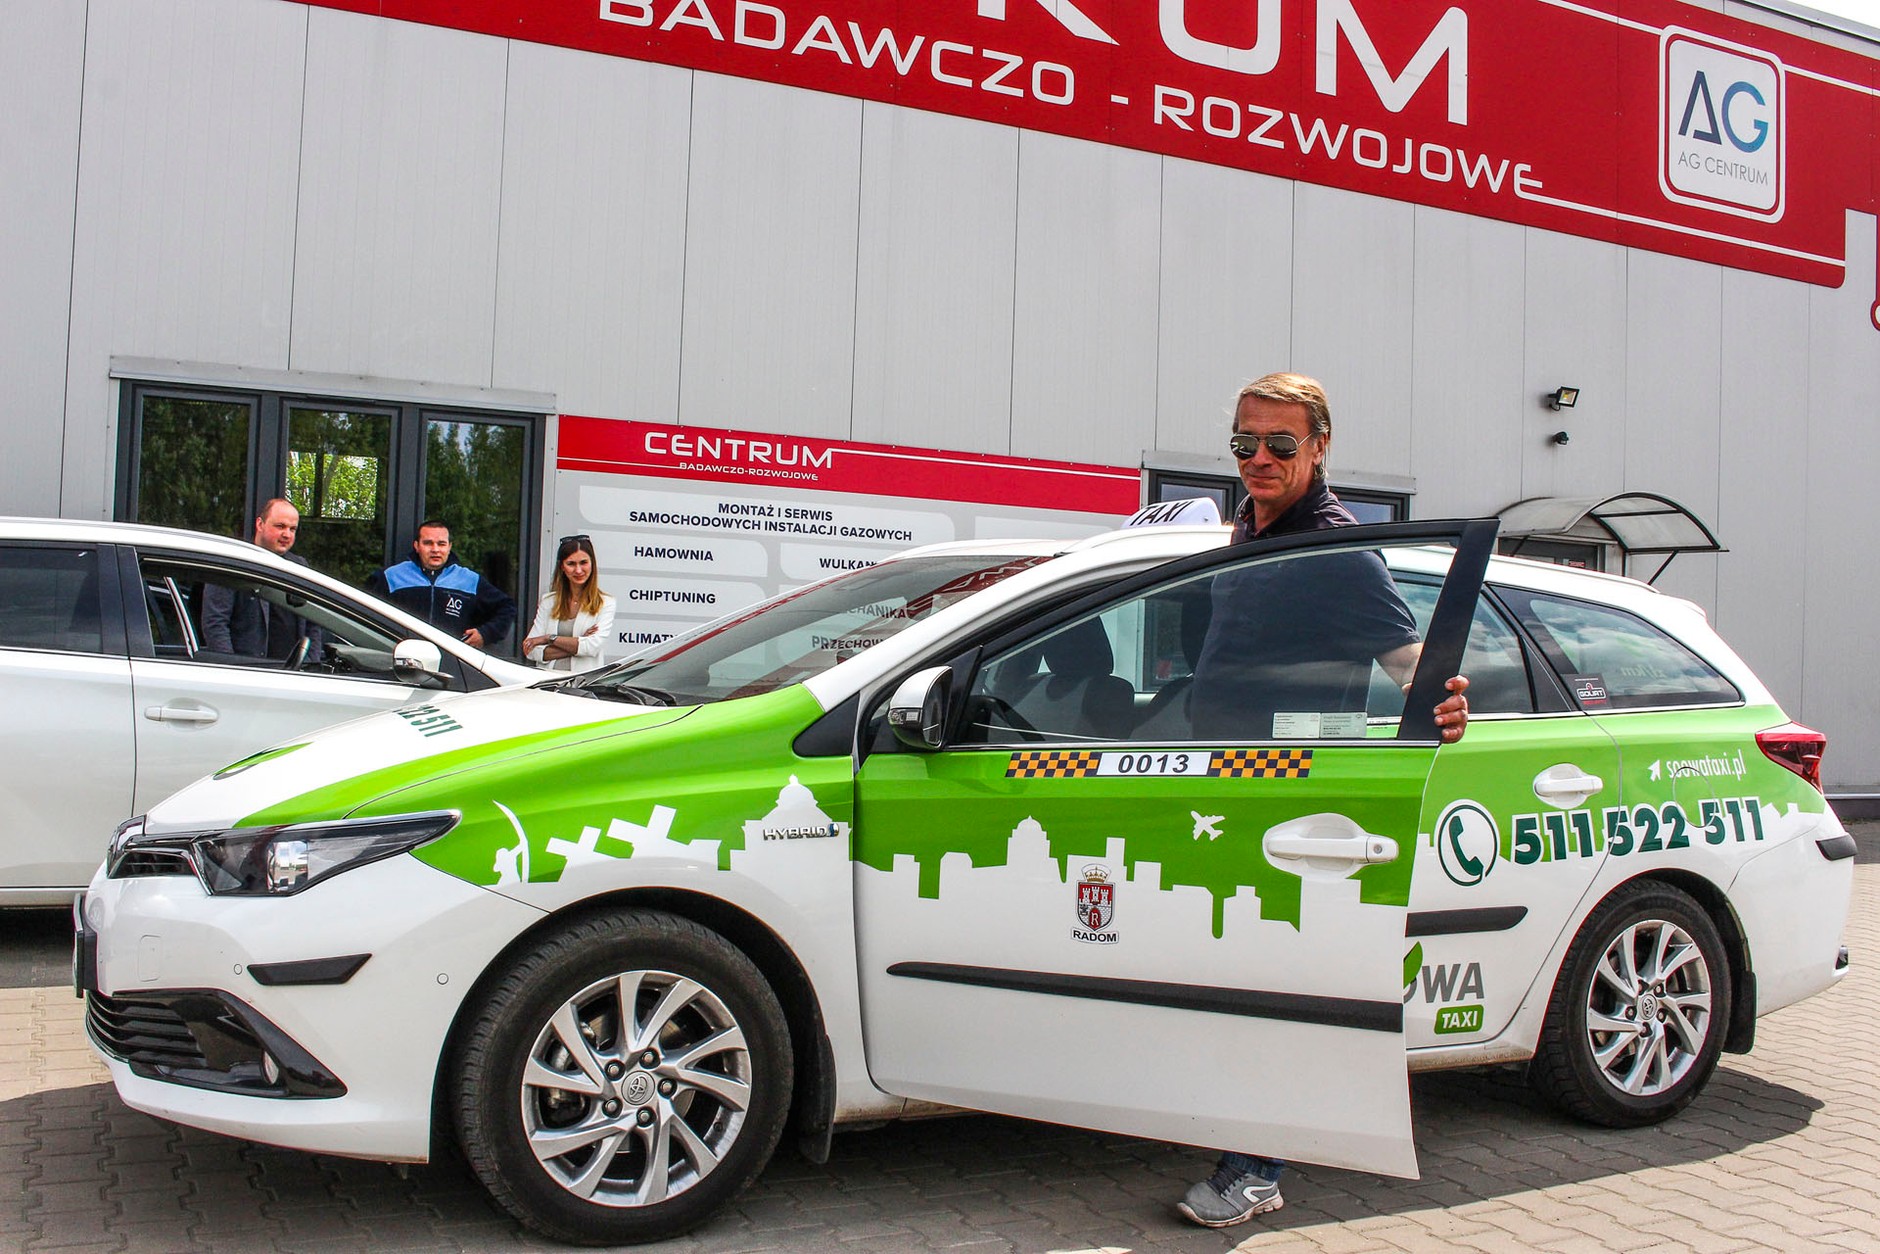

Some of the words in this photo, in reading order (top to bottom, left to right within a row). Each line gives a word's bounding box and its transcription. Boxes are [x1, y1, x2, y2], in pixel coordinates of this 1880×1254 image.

[1678, 70, 1769, 153] AG
[1153, 84, 1543, 197] ROZWOJOWE
[1678, 152, 1701, 170] AG
[1704, 156, 1769, 186] CENTRUM
[644, 431, 832, 468] CENTRUM
[679, 462, 819, 481] BADAWCZO-ROZWOJOWE
[718, 502, 774, 518] MONTAŻ
[777, 507, 782, 518] I
[784, 507, 833, 522] SERWIS
[1129, 500, 1195, 526] TAXI
[629, 511, 761, 531] SAMOCHODOWYCH
[764, 521, 837, 537] INSTALACJI
[840, 526, 912, 541] GAZOWYCH
[634, 545, 714, 562] HAMOWNIA
[446, 597, 463, 610] AG
[629, 589, 716, 604] CHIPTUNING
[410, 714, 463, 737] 511
[1118, 754, 1189, 774] 0013
[763, 826, 828, 841] HYBRID
[1513, 811, 1595, 866] 511
[1606, 804, 1690, 857] 522
[1701, 798, 1764, 846] 511
[1073, 929, 1117, 942] RADOM
[1441, 1010, 1479, 1029] TAXI
